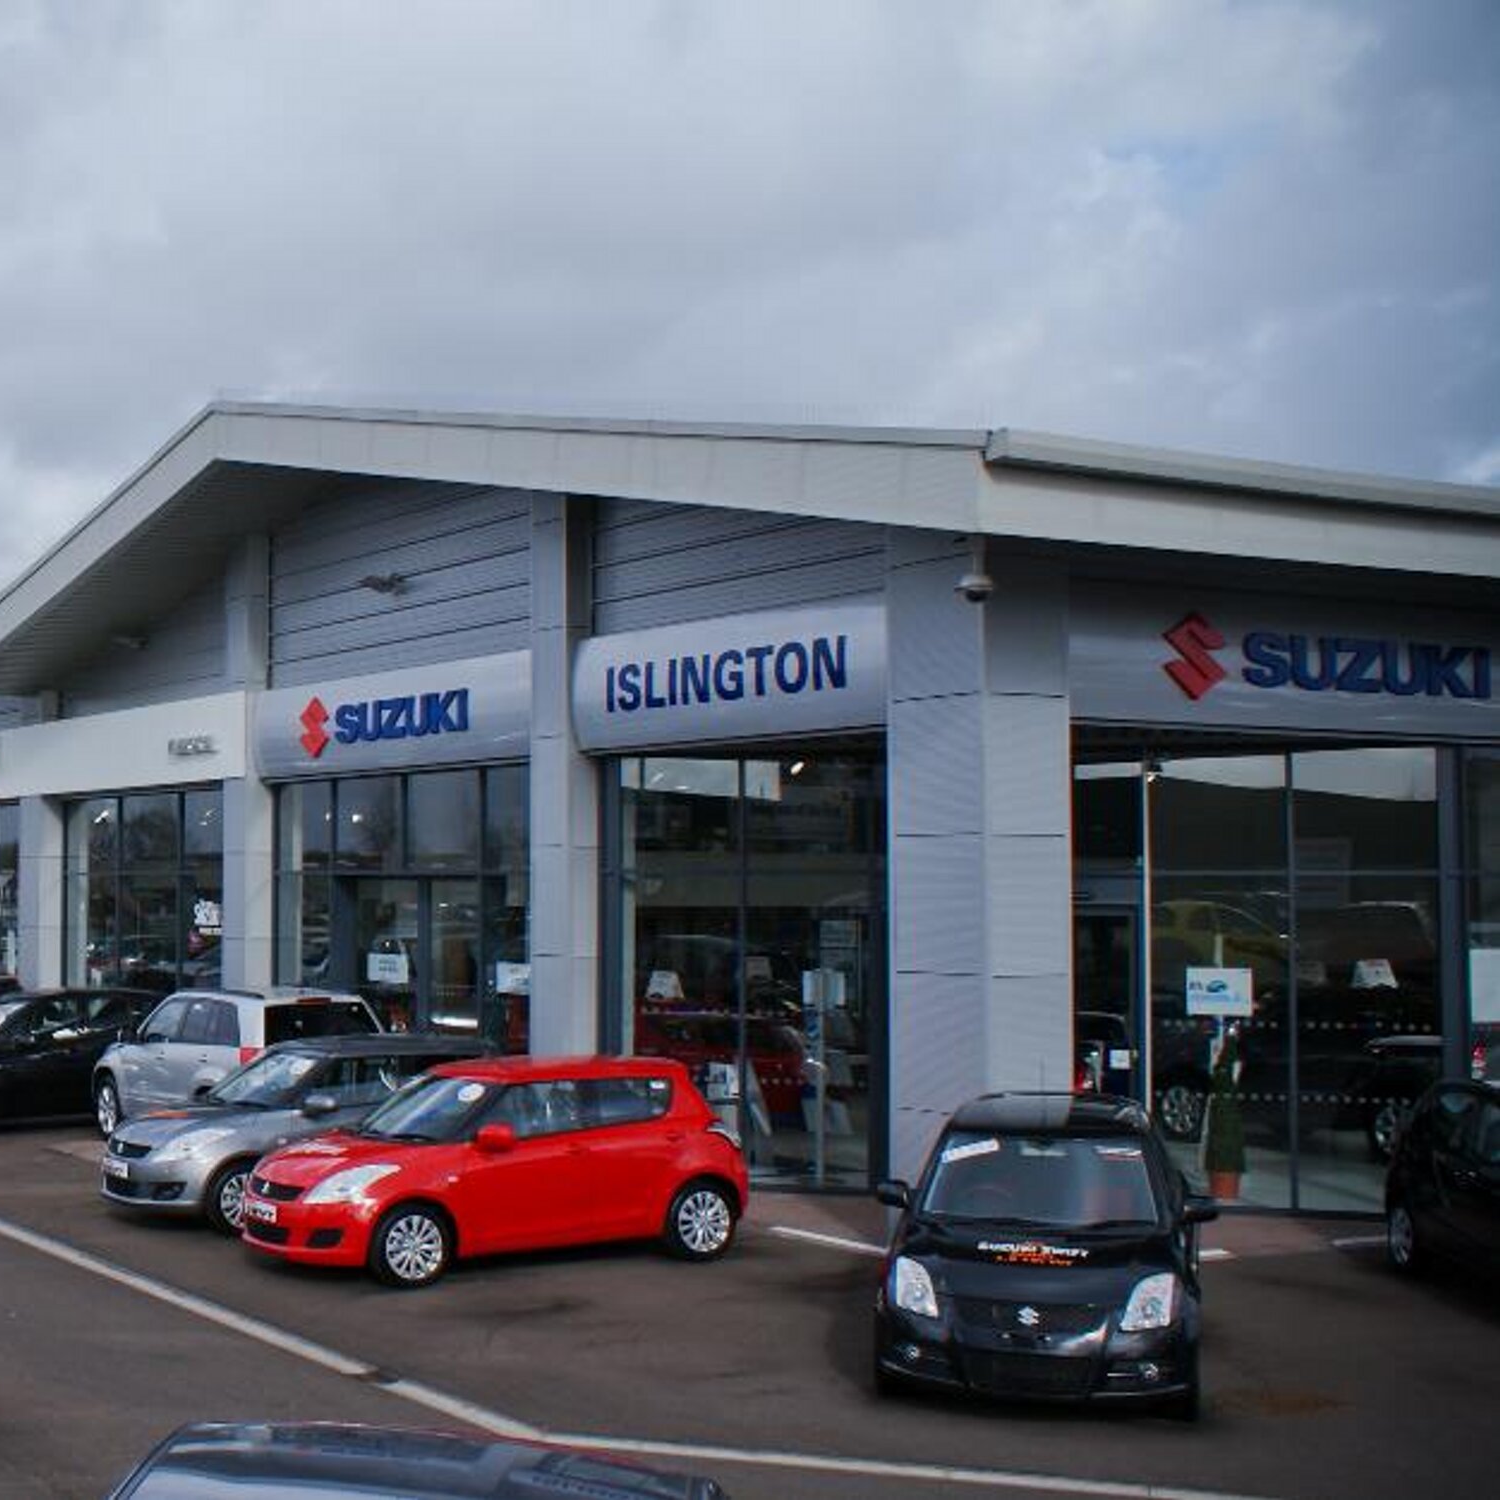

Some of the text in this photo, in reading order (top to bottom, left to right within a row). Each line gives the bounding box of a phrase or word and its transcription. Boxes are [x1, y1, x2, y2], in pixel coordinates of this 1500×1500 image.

[606, 635, 847, 713] ISLINGTON
[1241, 631, 1492, 699] SUZUKI
[335, 688, 469, 744] SUZUKI
